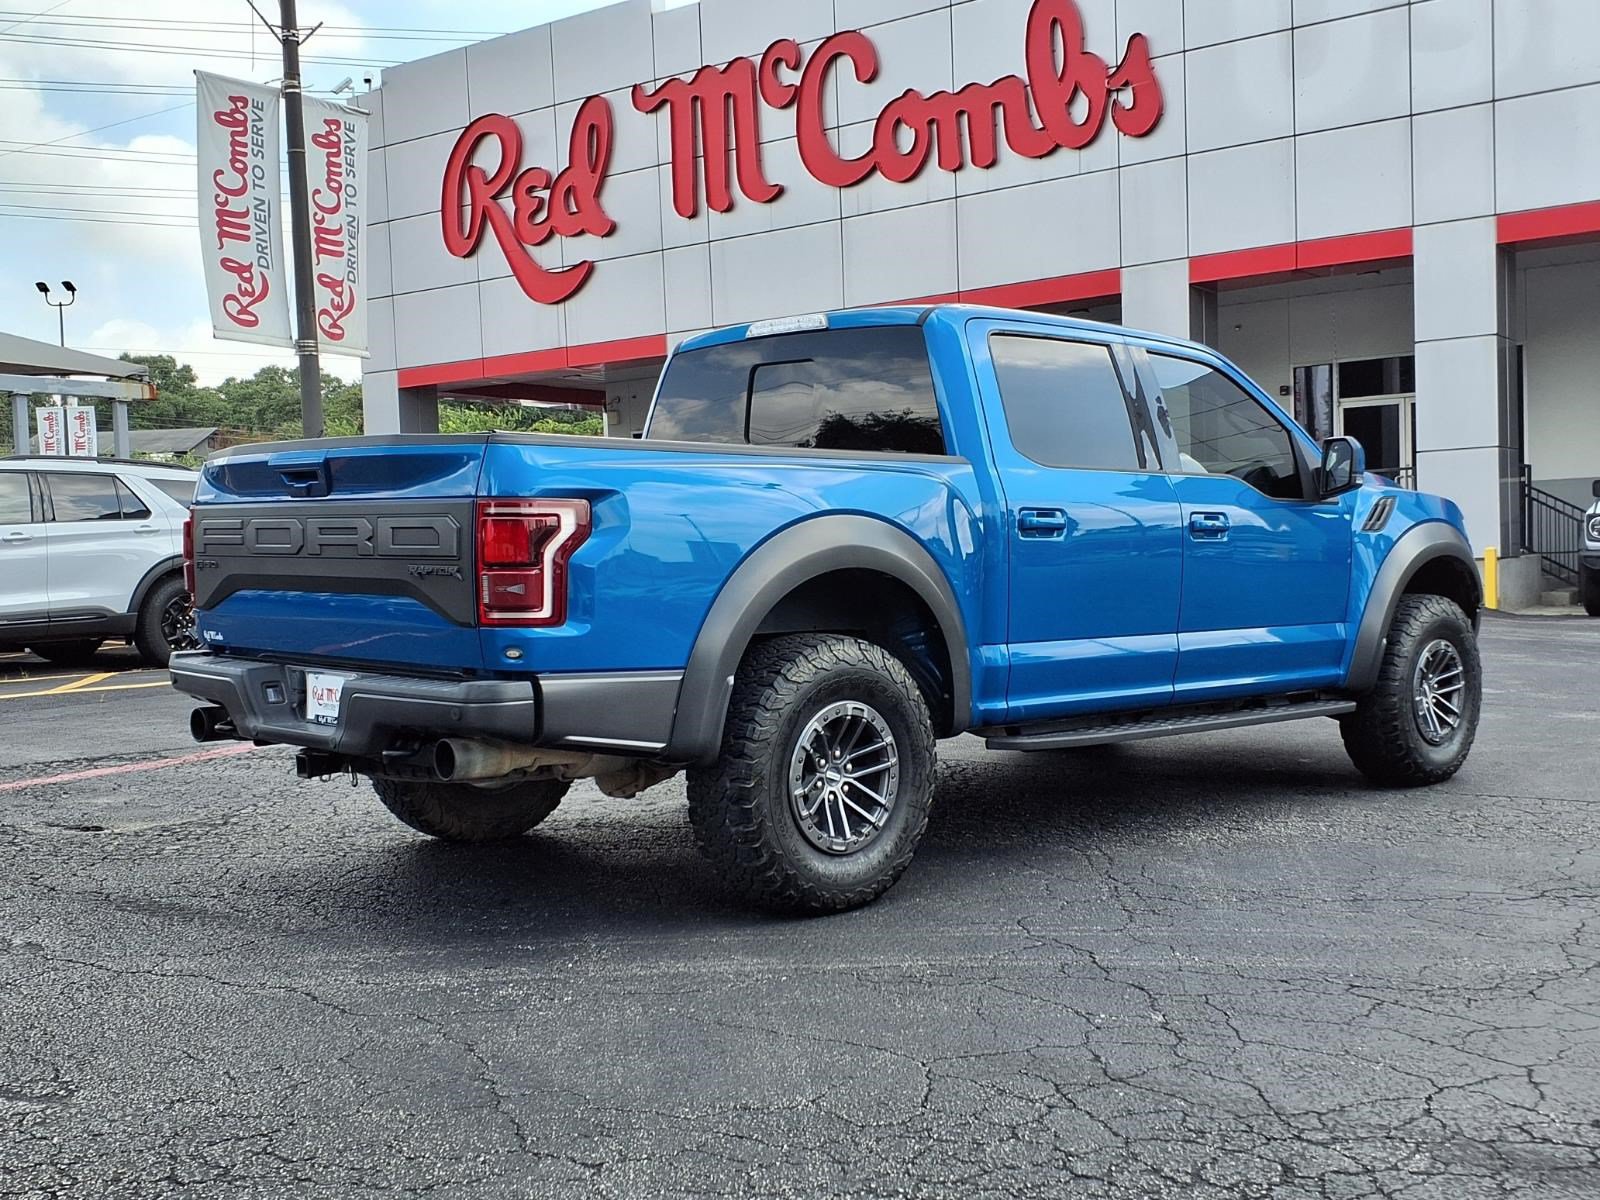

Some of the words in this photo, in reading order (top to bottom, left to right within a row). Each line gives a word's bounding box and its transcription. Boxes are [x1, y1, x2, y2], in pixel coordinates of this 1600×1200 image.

[251, 98, 264, 160] SERVE
[343, 121, 356, 179] SERVE
[441, 95, 617, 304] Red
[631, 0, 1163, 219] McCombs
[213, 95, 251, 250] McCombs
[251, 164, 266, 192] TO
[311, 119, 345, 266] McCombs
[344, 185, 358, 211] TO
[252, 197, 272, 270] DRIVEN
[346, 214, 357, 284] DRIVEN
[220, 257, 269, 328] Red
[317, 273, 355, 341] Red
[196, 514, 461, 558] FORD
[408, 564, 465, 584] RAPTOR
